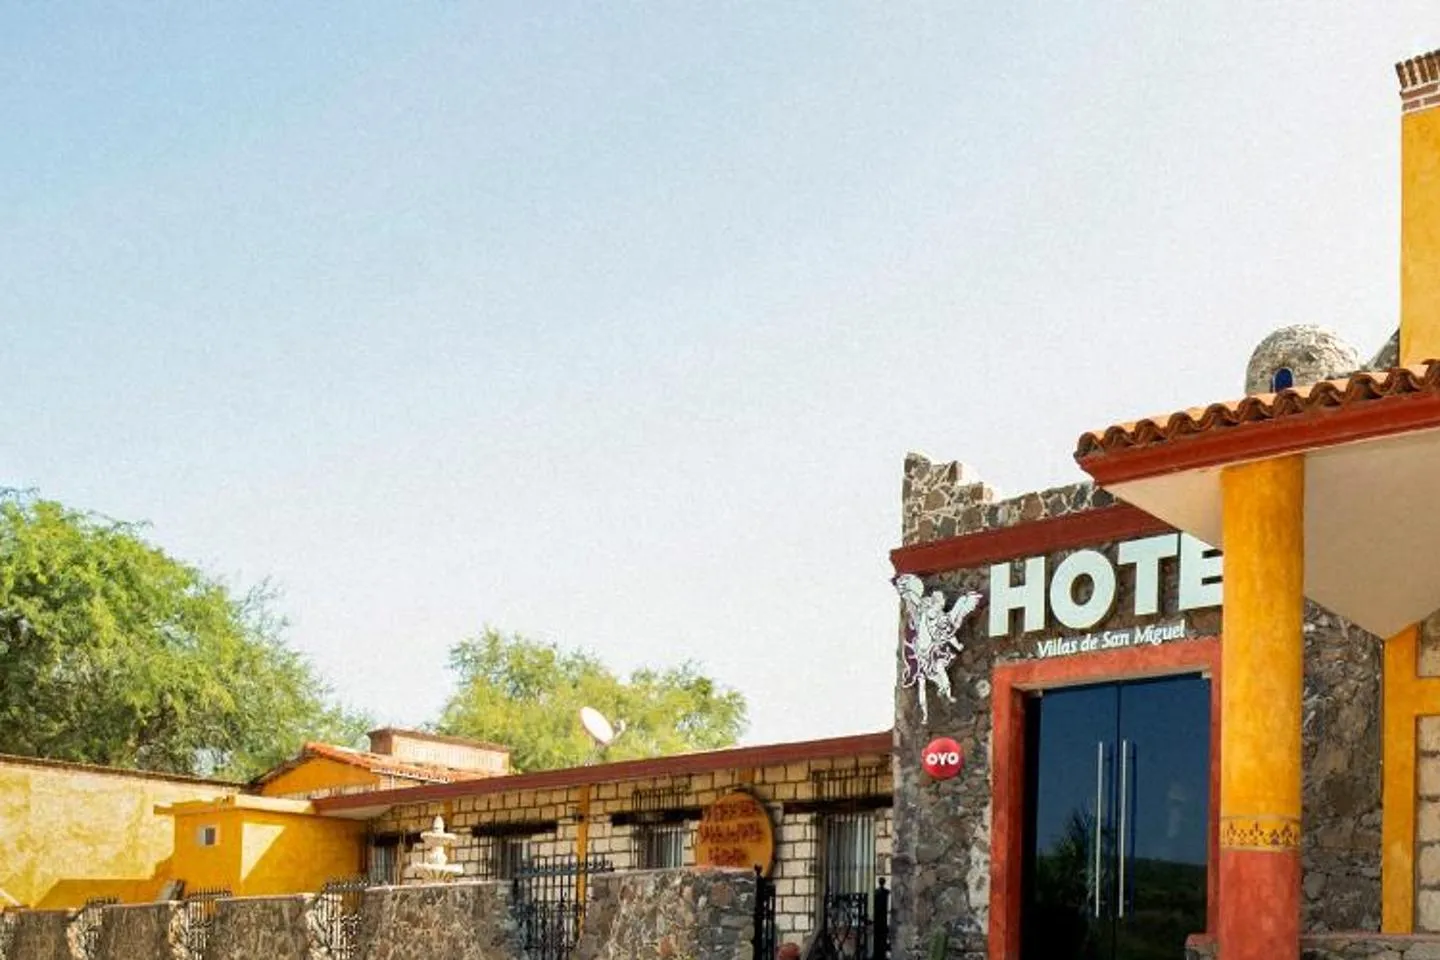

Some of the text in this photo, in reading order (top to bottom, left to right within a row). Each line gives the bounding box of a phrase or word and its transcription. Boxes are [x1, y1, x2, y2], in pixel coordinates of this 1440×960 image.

[988, 532, 1223, 638] HOTE
[1037, 619, 1186, 658] Villas de San Miguel
[926, 751, 959, 766] OYO
